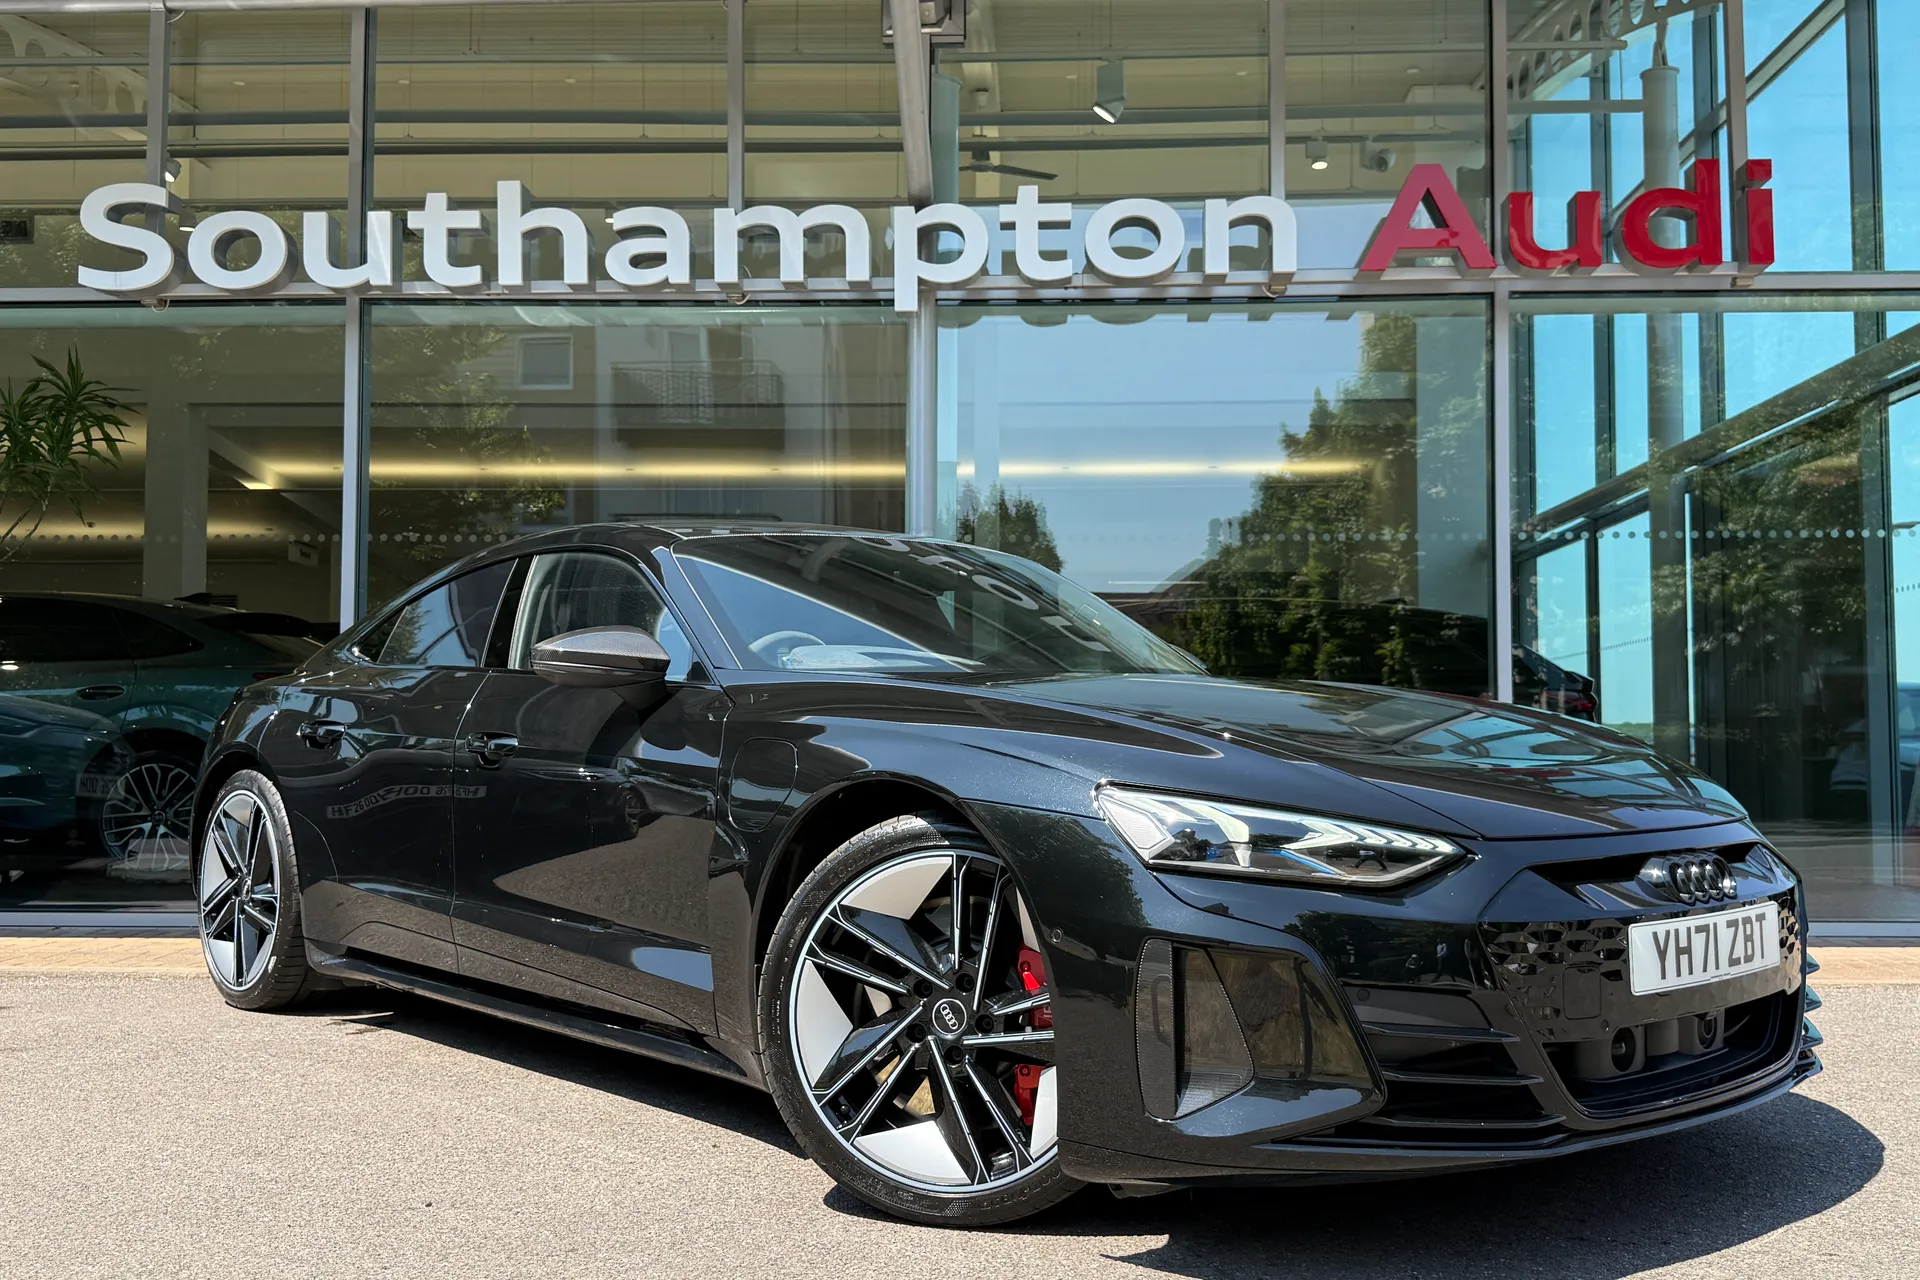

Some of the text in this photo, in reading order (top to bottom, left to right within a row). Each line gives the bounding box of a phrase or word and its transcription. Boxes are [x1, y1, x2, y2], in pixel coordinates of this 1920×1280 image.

[78, 158, 1775, 313] Southampton Audi
[1651, 912, 1766, 980] YH71 ZBT
